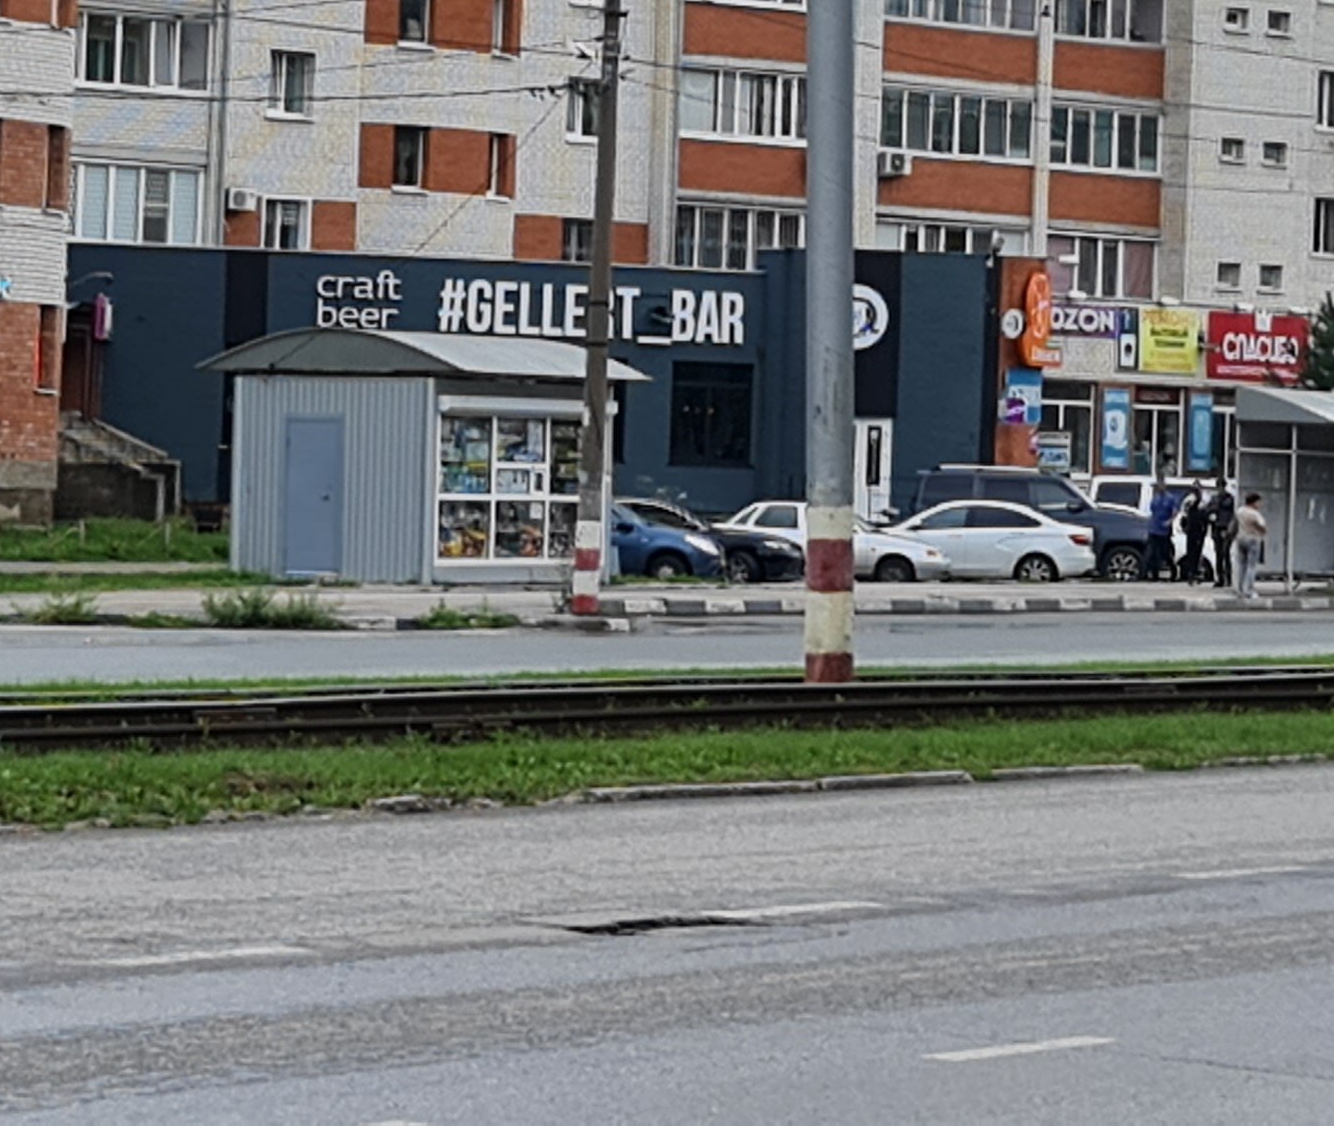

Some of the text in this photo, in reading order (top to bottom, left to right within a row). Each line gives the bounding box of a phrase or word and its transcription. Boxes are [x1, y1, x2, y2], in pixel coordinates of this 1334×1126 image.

[317, 271, 402, 301] craft
[317, 299, 398, 329] beer
[1050, 307, 1115, 332] OZON
